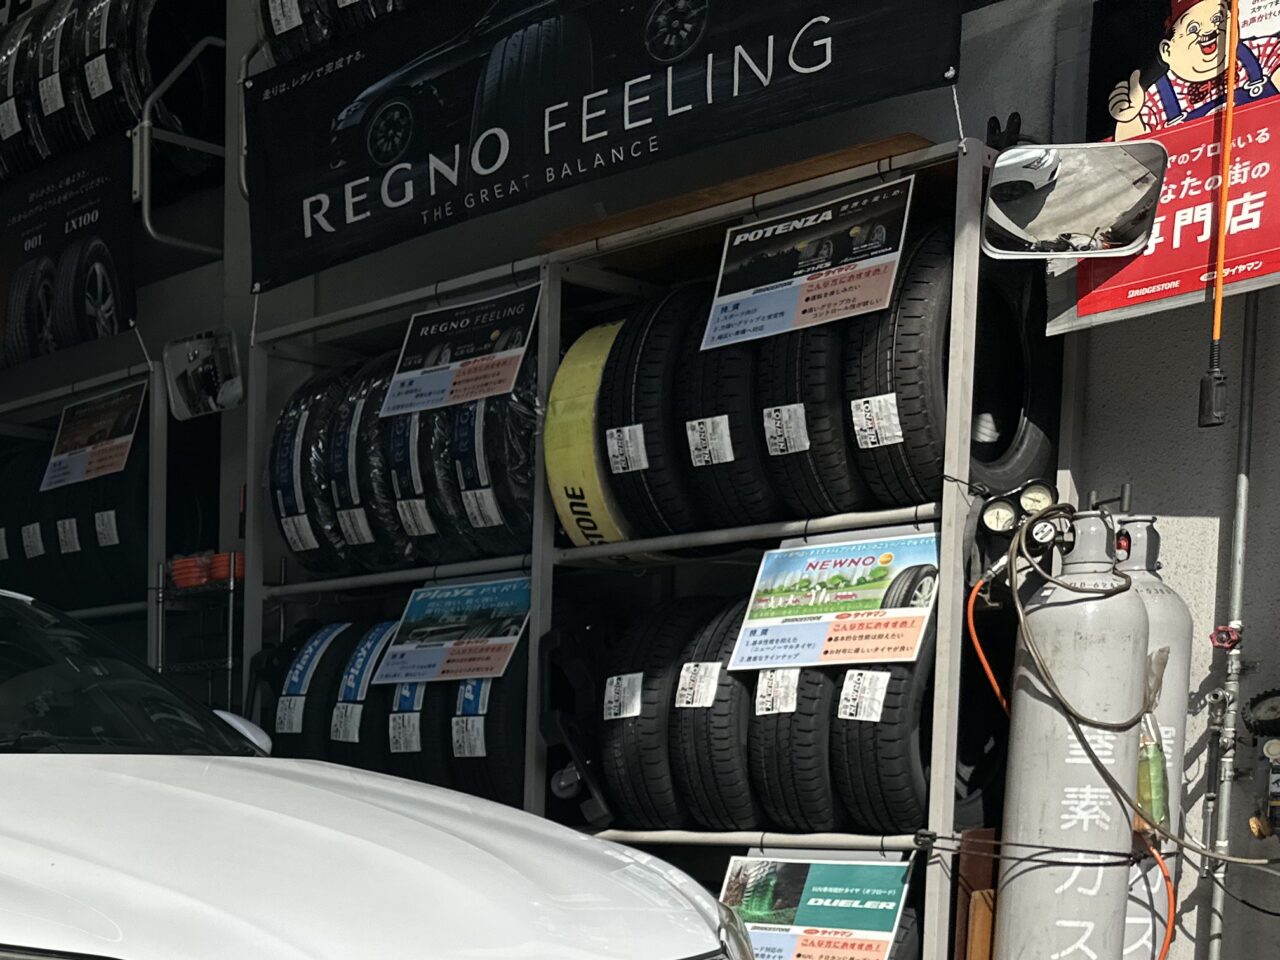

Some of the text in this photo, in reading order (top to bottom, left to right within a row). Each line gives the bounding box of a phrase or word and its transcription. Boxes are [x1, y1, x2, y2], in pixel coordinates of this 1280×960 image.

[301, 15, 834, 240] REGNO FEELING
[421, 135, 661, 226] THE GREAT BALANCE
[732, 209, 833, 247] POTENZA
[1127, 280, 1180, 298] BRIDGESTONE
[420, 318, 470, 337] REGNO
[474, 303, 526, 325] FEELING
[805, 556, 876, 571] NEWNO
[806, 897, 897, 910] DUELER
